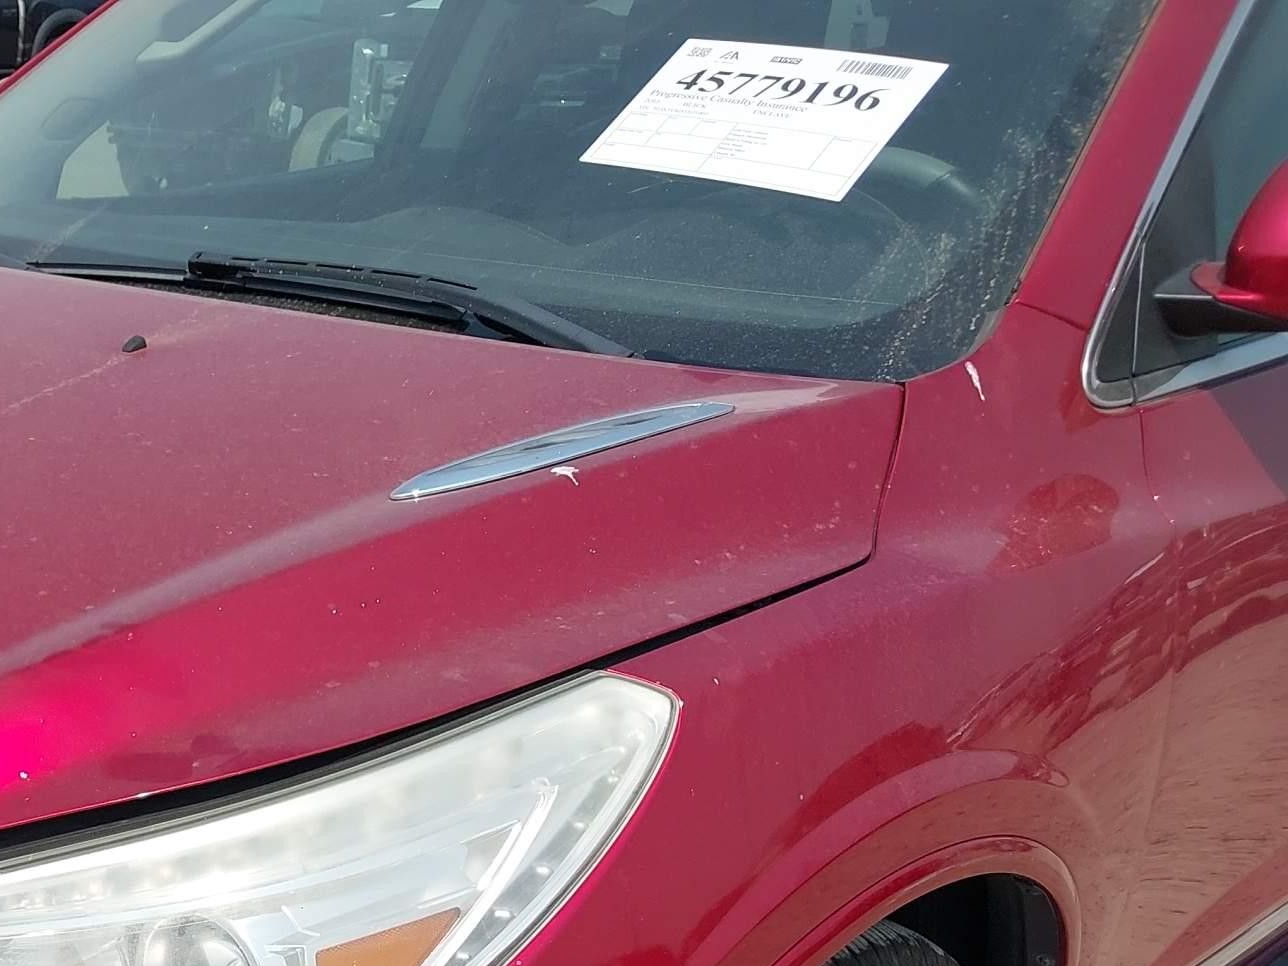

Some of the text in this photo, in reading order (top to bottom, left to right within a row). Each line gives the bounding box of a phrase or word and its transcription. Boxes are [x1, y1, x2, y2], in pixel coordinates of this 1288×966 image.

[650, 89, 708, 102] Progressive
[709, 93, 755, 107] Casualty
[756, 99, 809, 112] Insurance
[676, 68, 891, 112] 45779196
